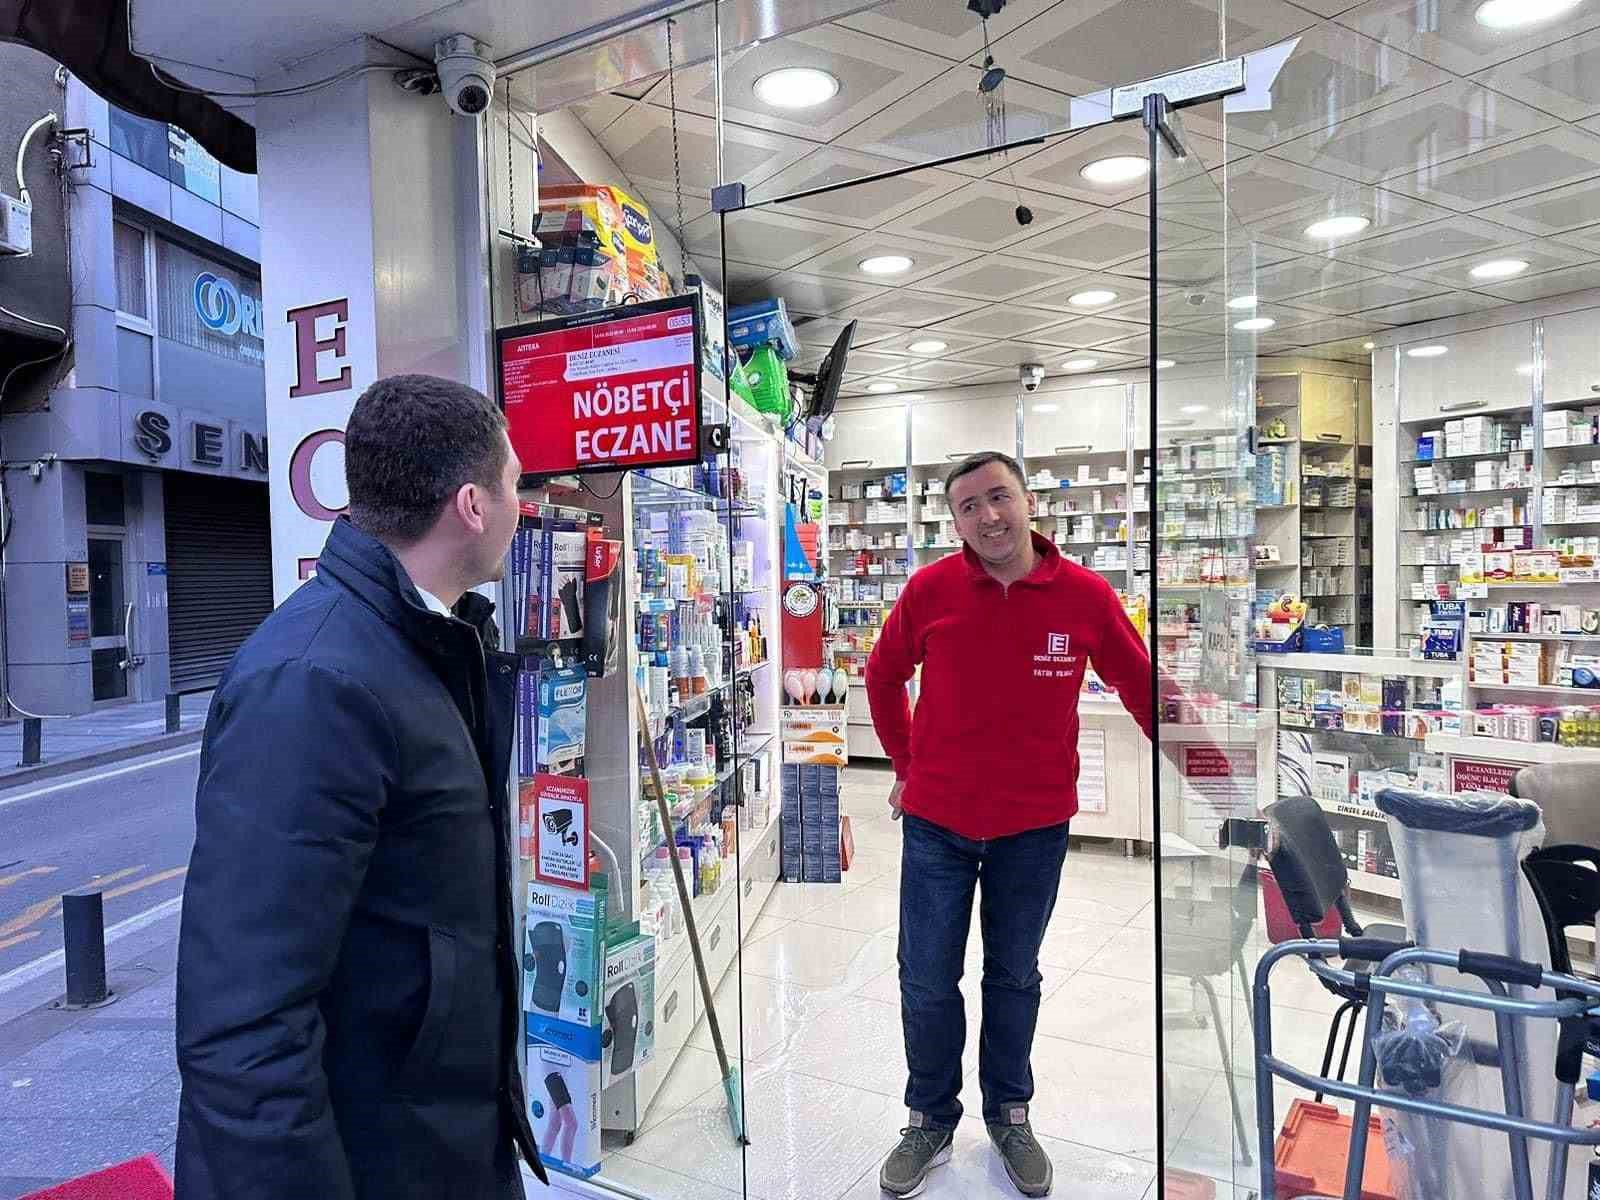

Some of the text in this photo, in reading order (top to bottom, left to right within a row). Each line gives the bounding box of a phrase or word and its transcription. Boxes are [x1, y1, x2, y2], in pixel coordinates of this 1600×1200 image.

[573, 370, 690, 419] NÖBETÇİ
[576, 418, 692, 460] ECZANE
[531, 891, 550, 907] Roll
[607, 960, 624, 978] Roll
